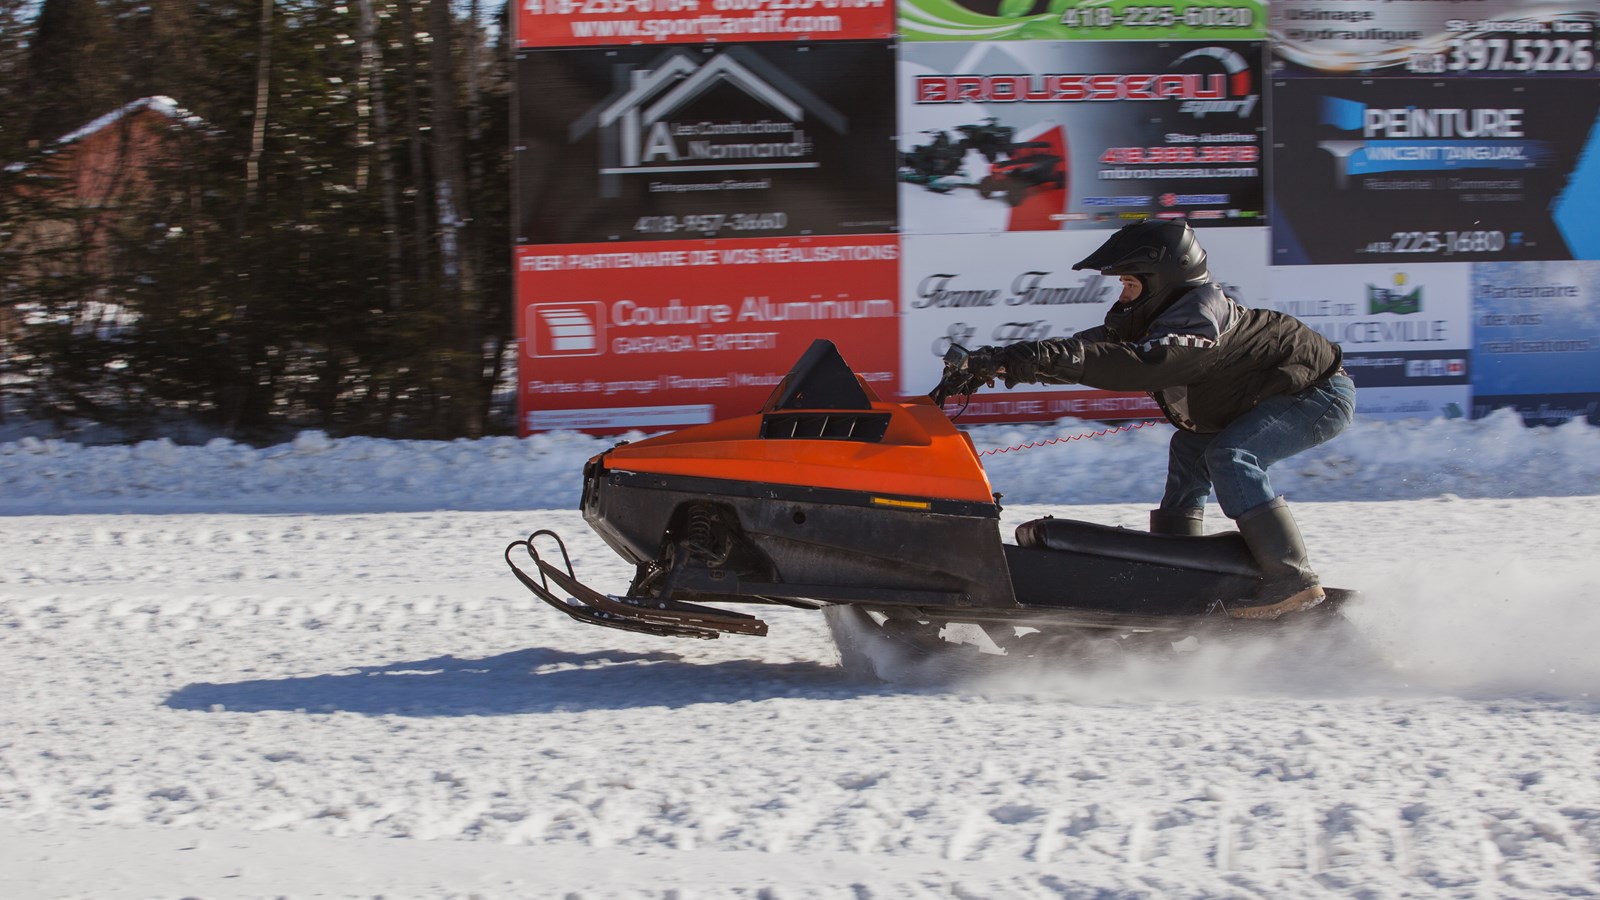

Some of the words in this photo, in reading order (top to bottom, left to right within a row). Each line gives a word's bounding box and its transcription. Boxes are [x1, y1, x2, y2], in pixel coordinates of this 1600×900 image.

[571, 11, 842, 39] www.sporttardif.com
[1060, 7, 1254, 27] 418-225-6020
[1284, 8, 1376, 22] Usinage
[1284, 28, 1424, 42] Hydraulique
[1447, 39, 1594, 71] 397.5226
[914, 74, 1227, 103] BROUSSEAU
[1178, 95, 1259, 118] sport
[1364, 108, 1524, 137] PEINTURE
[686, 129, 805, 160] Normand
[1366, 147, 1440, 160] VINCENT
[634, 212, 788, 233] 418-957-3660
[1391, 231, 1505, 253] 225-1680
[520, 255, 564, 271] FIER
[567, 251, 688, 269] PARTENAIRE
[689, 250, 720, 266] DE
[721, 248, 761, 265] VOS
[763, 243, 899, 263] RÉALISATIONS
[1480, 283, 1579, 299] Partenaire
[612, 298, 732, 326] Couture
[736, 294, 894, 322] Aluminium
[1480, 312, 1507, 327] de
[1508, 313, 1542, 326] vos
[612, 335, 696, 354] GARAGA
[697, 332, 779, 352] EXPERT
[1480, 337, 1589, 353] réalisations
